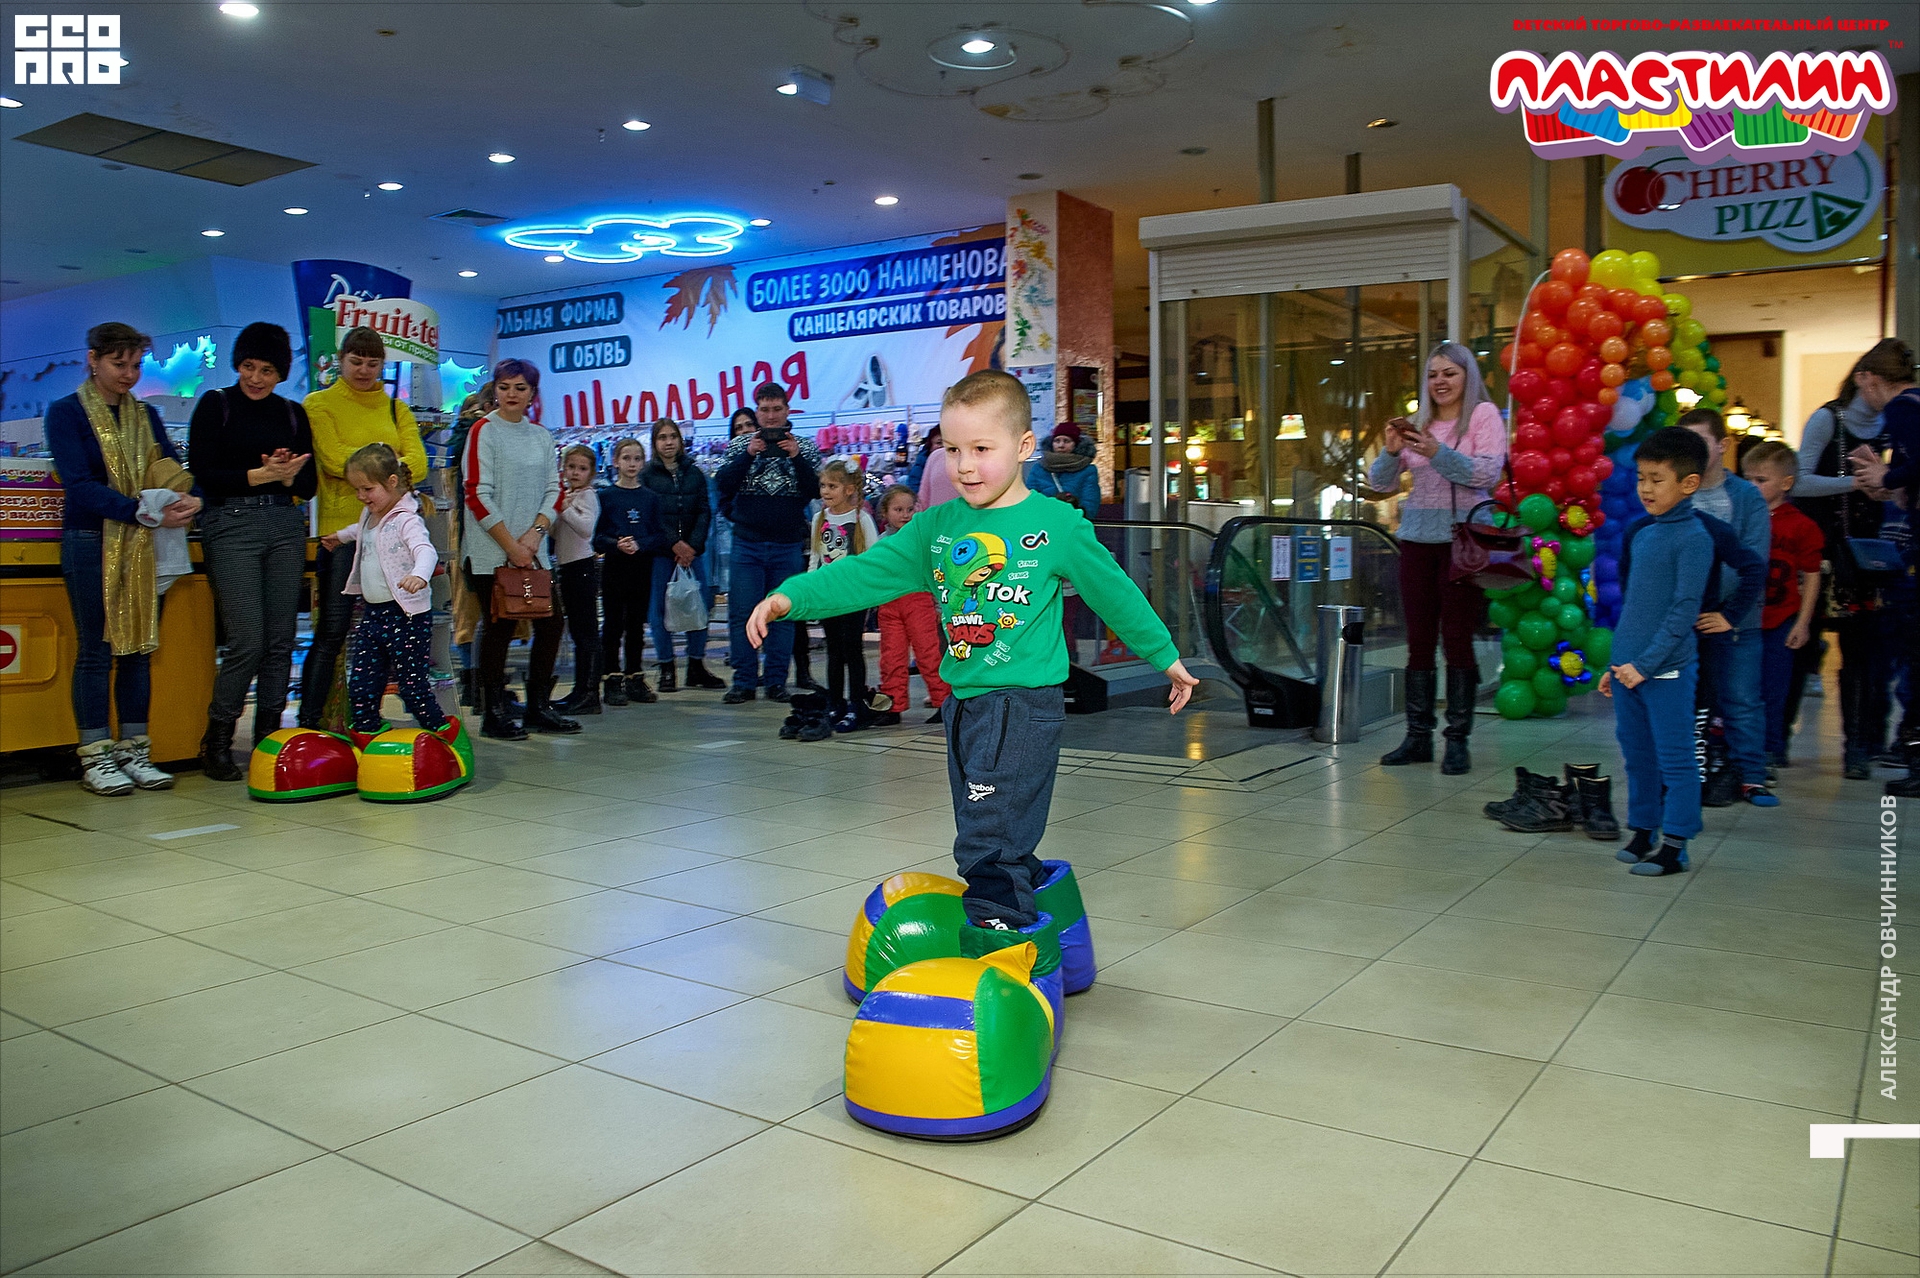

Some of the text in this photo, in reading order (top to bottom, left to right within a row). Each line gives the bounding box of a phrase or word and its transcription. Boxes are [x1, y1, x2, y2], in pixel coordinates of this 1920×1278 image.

[1648, 154, 1838, 211] CHERRY
[752, 273, 812, 307] БОЛЕЕ
[819, 268, 871, 298] 3000
[559, 297, 618, 327] ФОРМА
[793, 291, 1007, 337] КАНЦЕЛЯРСКИХ ТОВАРОВ
[554, 340, 627, 370] И ОБУВЬ
